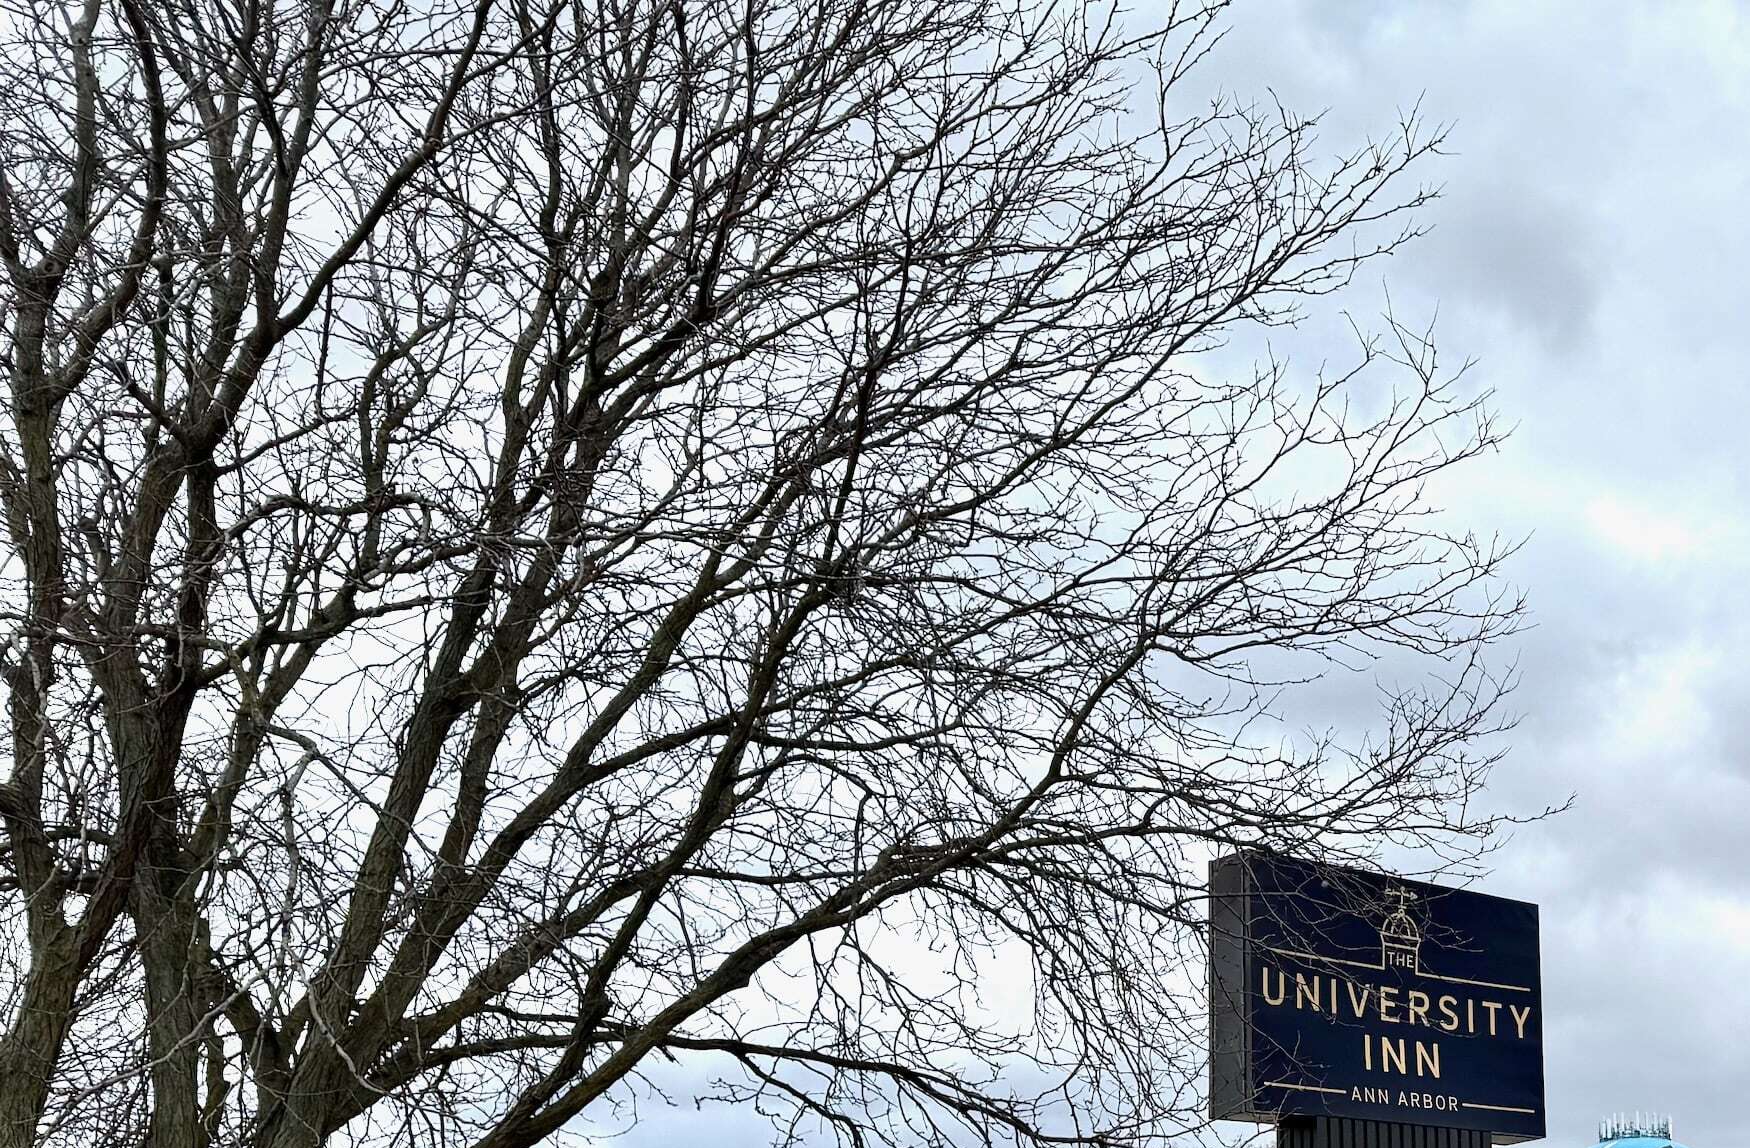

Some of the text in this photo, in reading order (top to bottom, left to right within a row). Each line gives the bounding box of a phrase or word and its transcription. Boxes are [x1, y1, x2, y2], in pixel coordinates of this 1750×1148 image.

[1387, 951, 1414, 968] THE
[1262, 966, 1531, 1039] UNIVERSITY
[1364, 1034, 1440, 1079] INN
[1351, 1086, 1458, 1112] ANN ARBOR
